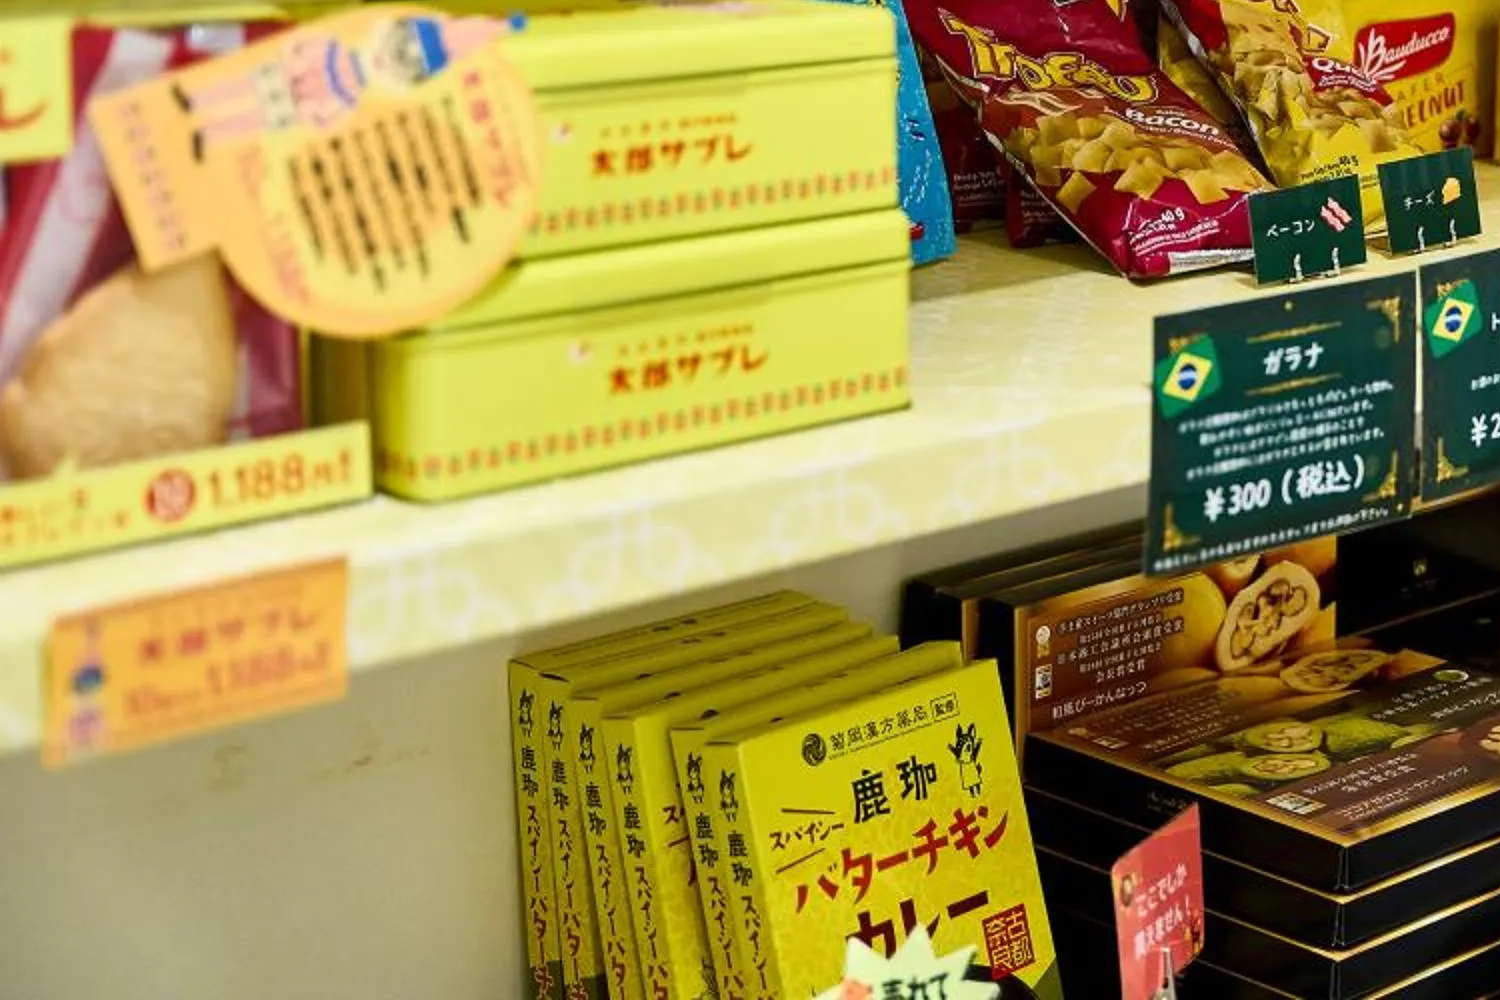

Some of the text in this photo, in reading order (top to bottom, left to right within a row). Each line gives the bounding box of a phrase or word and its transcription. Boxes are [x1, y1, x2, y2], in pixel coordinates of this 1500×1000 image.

[1396, 72, 1448, 100] AFER
[1402, 81, 1466, 128] ELNUT
[1125, 108, 1219, 136] Bacon
[1404, 191, 1435, 212] チーズ
[1266, 217, 1316, 240] ベーコン
[1263, 343, 1324, 375] ガラナ
[1204, 454, 1365, 522] ¥300 (税込)
[853, 756, 938, 824] 鹿珈
[769, 822, 844, 851] スパイシー
[796, 805, 1009, 914] バターチキン
